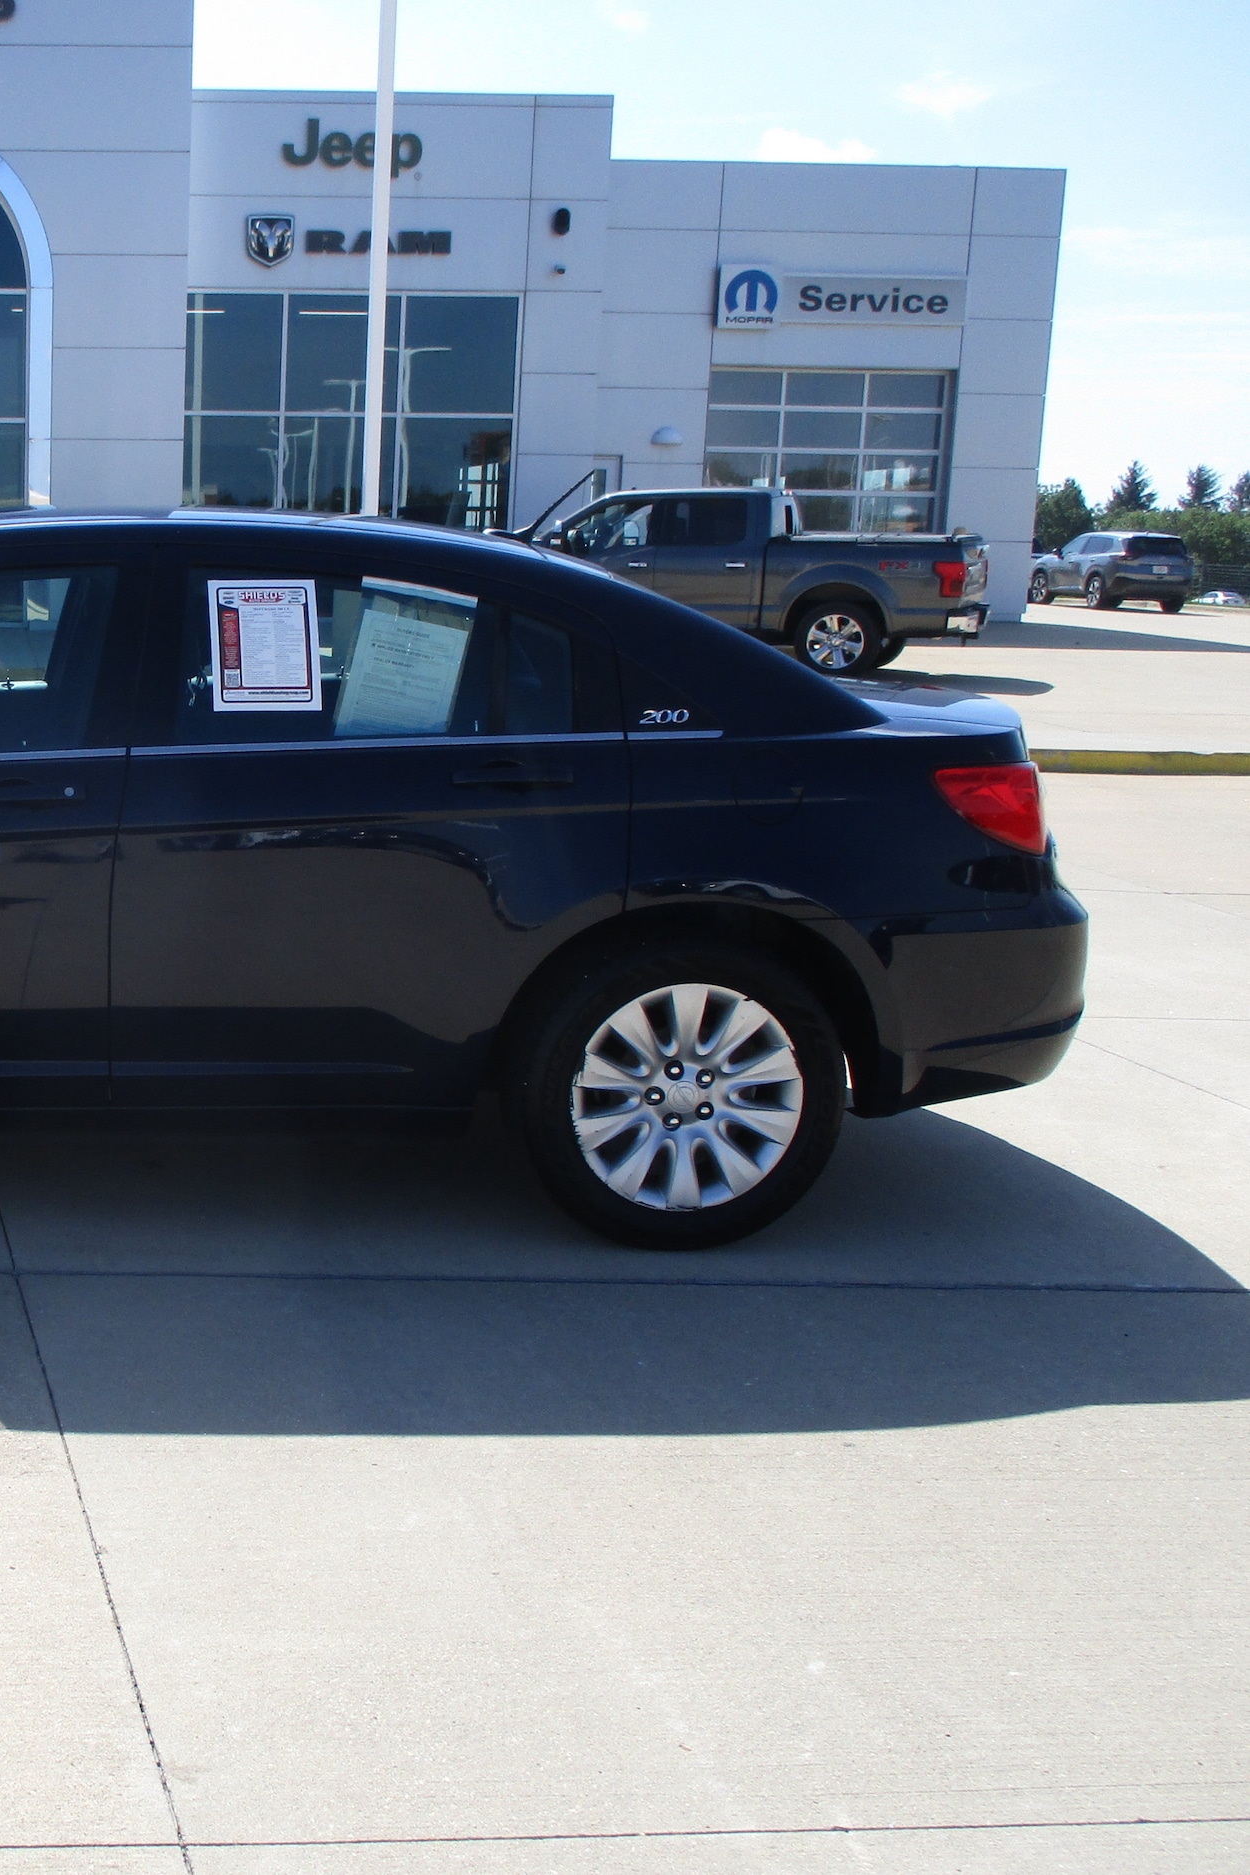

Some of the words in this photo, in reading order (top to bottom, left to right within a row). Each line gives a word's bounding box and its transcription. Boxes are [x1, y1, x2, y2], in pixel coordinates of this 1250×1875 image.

[283, 118, 423, 178] Jeep
[799, 285, 949, 314] Service
[725, 316, 774, 324] MOPAR
[238, 590, 286, 600] SHIELDS
[639, 709, 689, 724] 200
